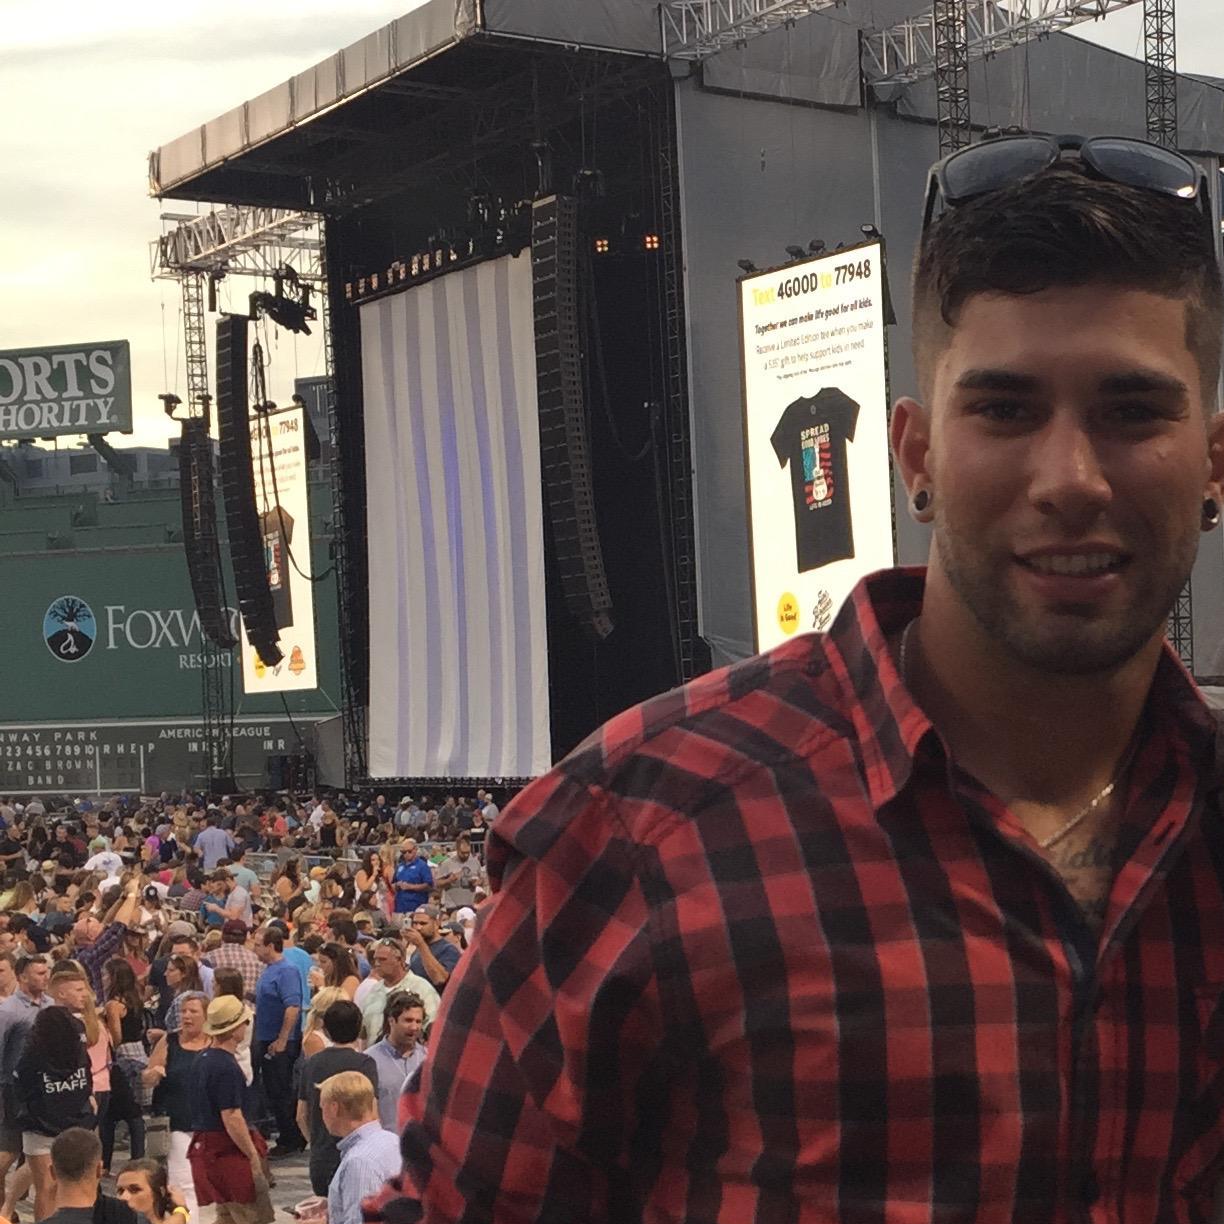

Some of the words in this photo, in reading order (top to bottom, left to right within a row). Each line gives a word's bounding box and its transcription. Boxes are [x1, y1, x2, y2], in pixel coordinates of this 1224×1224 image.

[777, 272, 818, 300] 4GOOD
[834, 259, 872, 285] 77948
[755, 321, 779, 336] Together
[825, 304, 840, 320] good
[840, 302, 849, 313] for
[104, 605, 239, 650] FOXW
[54, 730, 98, 742] PARK
[7, 760, 33, 771] ZAC
[45, 759, 94, 771] BROWN
[28, 775, 64, 785] BAND
[44, 1079, 87, 1094] STAFF
